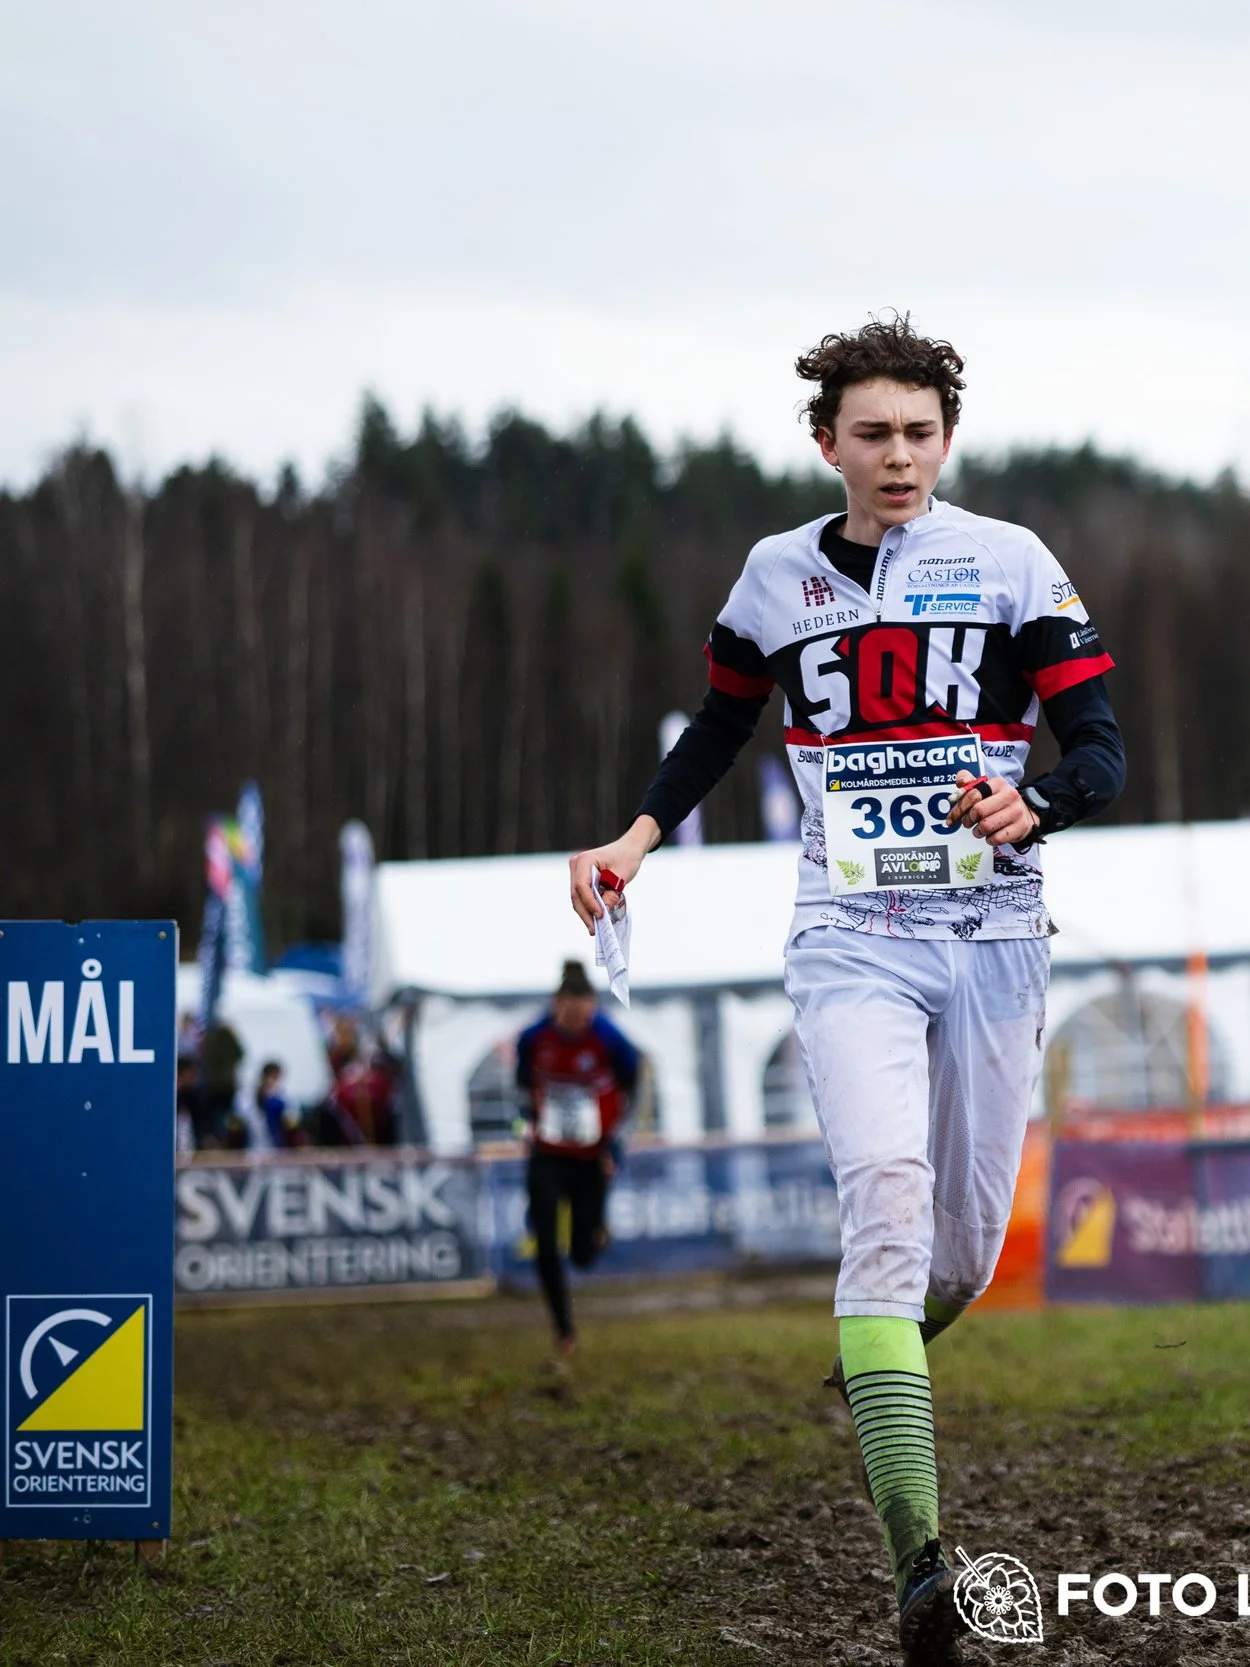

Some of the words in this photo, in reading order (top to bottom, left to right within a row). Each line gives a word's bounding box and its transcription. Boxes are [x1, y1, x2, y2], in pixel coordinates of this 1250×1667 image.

[876, 548, 894, 601] noname
[917, 556, 976, 566] noname
[908, 567, 980, 583] CASTOR
[930, 603, 980, 611] SERVICE
[792, 609, 859, 635] HEDERN
[800, 628, 987, 734] SOK
[827, 744, 978, 775] bagheera
[841, 777, 916, 789] KOLMÅRDSMEDELN
[933, 775, 946, 784] #2
[851, 792, 963, 840] 369
[880, 851, 941, 862] GODKÄNDA
[881, 860, 941, 873] AVLOPP
[6, 959, 155, 1064] MÅL
[177, 1163, 454, 1240] SVENSK
[177, 1234, 460, 1291] ORIENTERING
[15, 1441, 144, 1470] SVENSK
[13, 1475, 145, 1493] ORIENTERING
